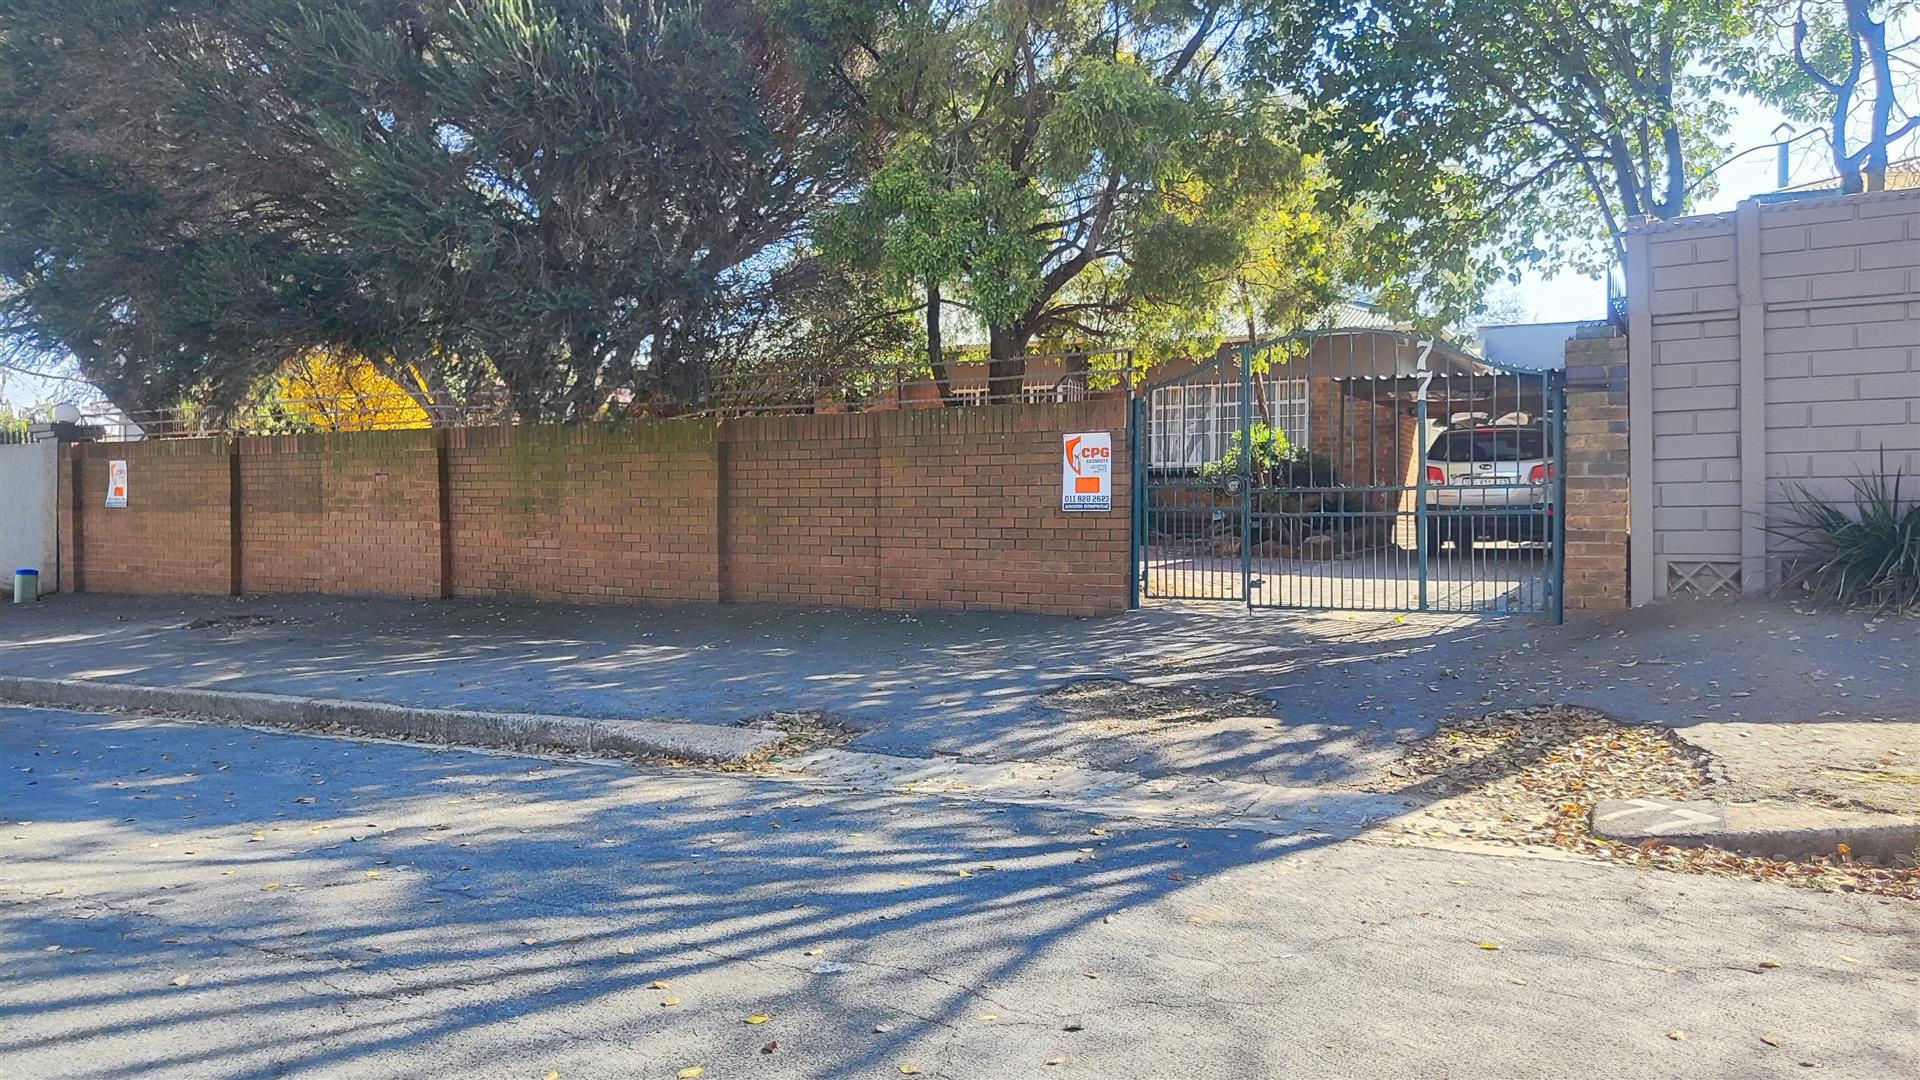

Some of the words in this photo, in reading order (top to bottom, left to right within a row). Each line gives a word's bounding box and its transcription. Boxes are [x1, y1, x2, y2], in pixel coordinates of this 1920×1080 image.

[1081, 447, 1110, 458] CPG
[1064, 495, 1076, 503] 011
[1092, 495, 1109, 503] 2623
